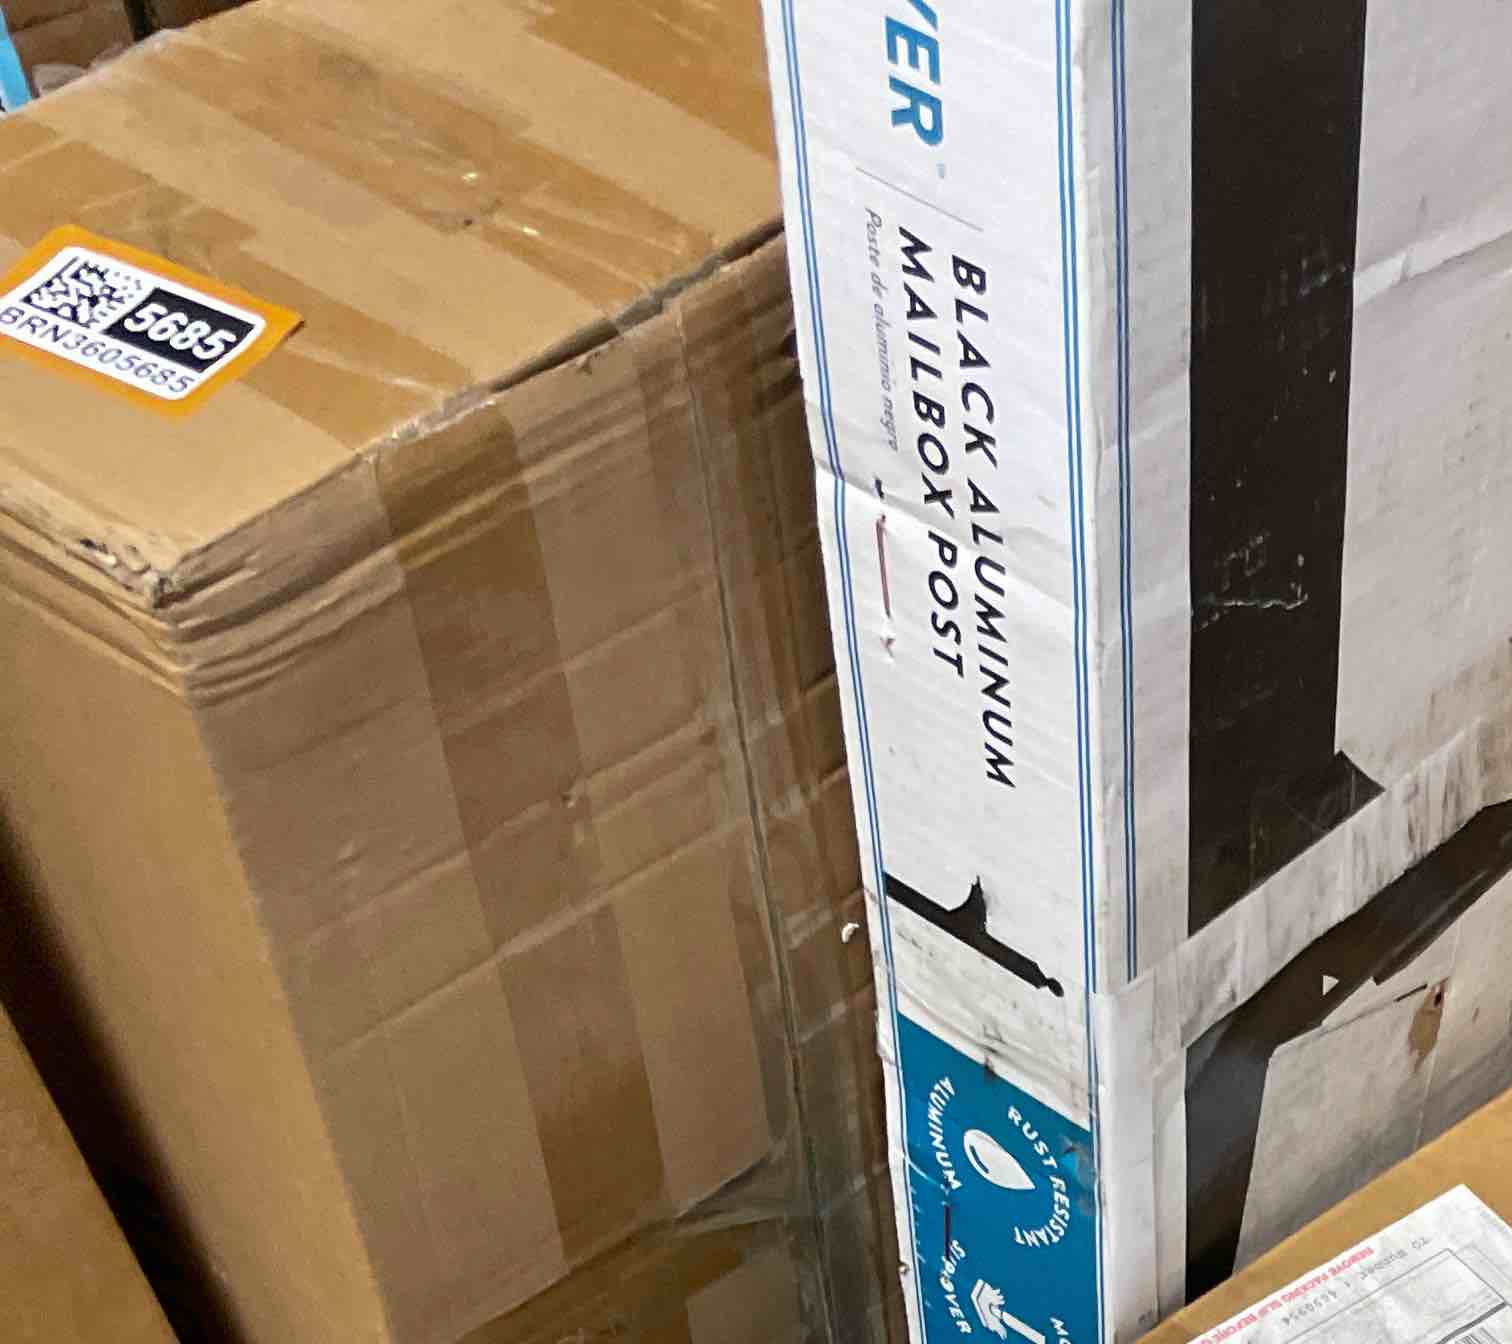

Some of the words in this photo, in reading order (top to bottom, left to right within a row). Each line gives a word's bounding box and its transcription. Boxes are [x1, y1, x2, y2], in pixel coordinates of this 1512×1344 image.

[865, 207, 884, 267] Poste
[868, 273, 886, 301] de
[0, 306, 196, 393] BRN3605685
[123, 302, 237, 360] 5685
[953, 254, 998, 470] BLACK
[897, 225, 956, 521] MAILBOX
[929, 530, 965, 679] POST
[967, 494, 1014, 790] ALUMINUM
[927, 1075, 963, 1192] ALUMINUM
[1007, 1105, 1058, 1170] RUST
[1013, 1173, 1071, 1250] RESISTANT
